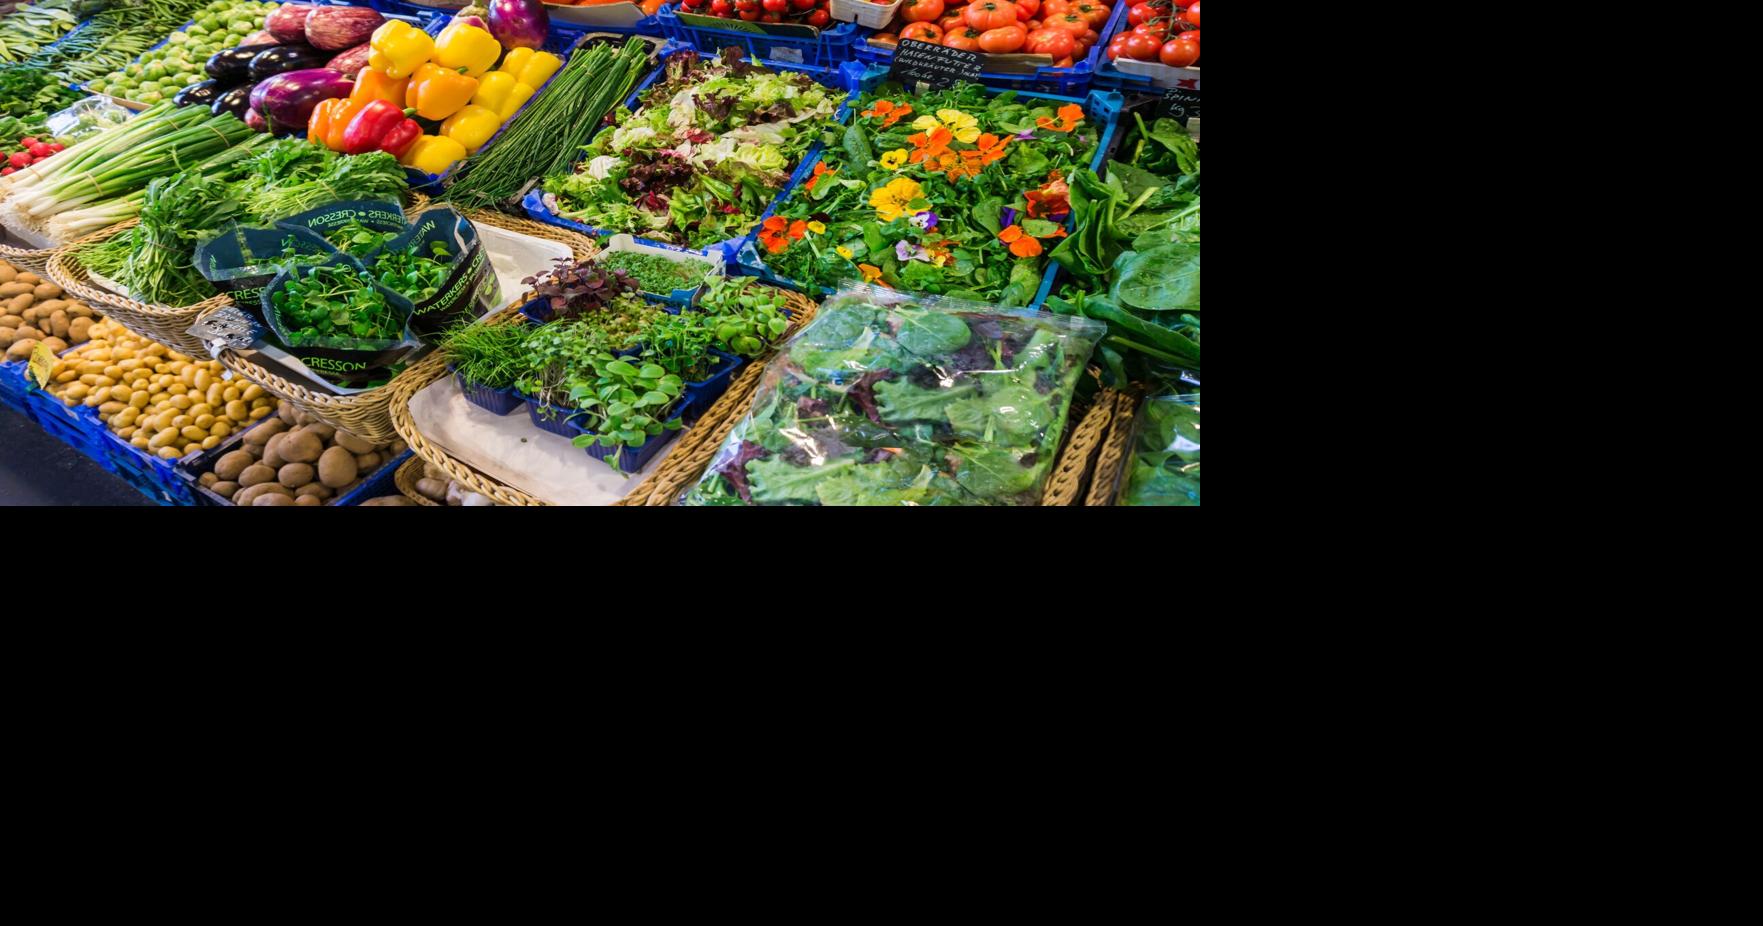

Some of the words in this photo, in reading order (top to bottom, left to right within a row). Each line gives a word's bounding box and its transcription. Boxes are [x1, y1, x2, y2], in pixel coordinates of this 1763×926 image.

[901, 39, 977, 61] OBERRÄDER
[413, 273, 468, 316] WATERKERS
[301, 356, 367, 372] CRESSON
